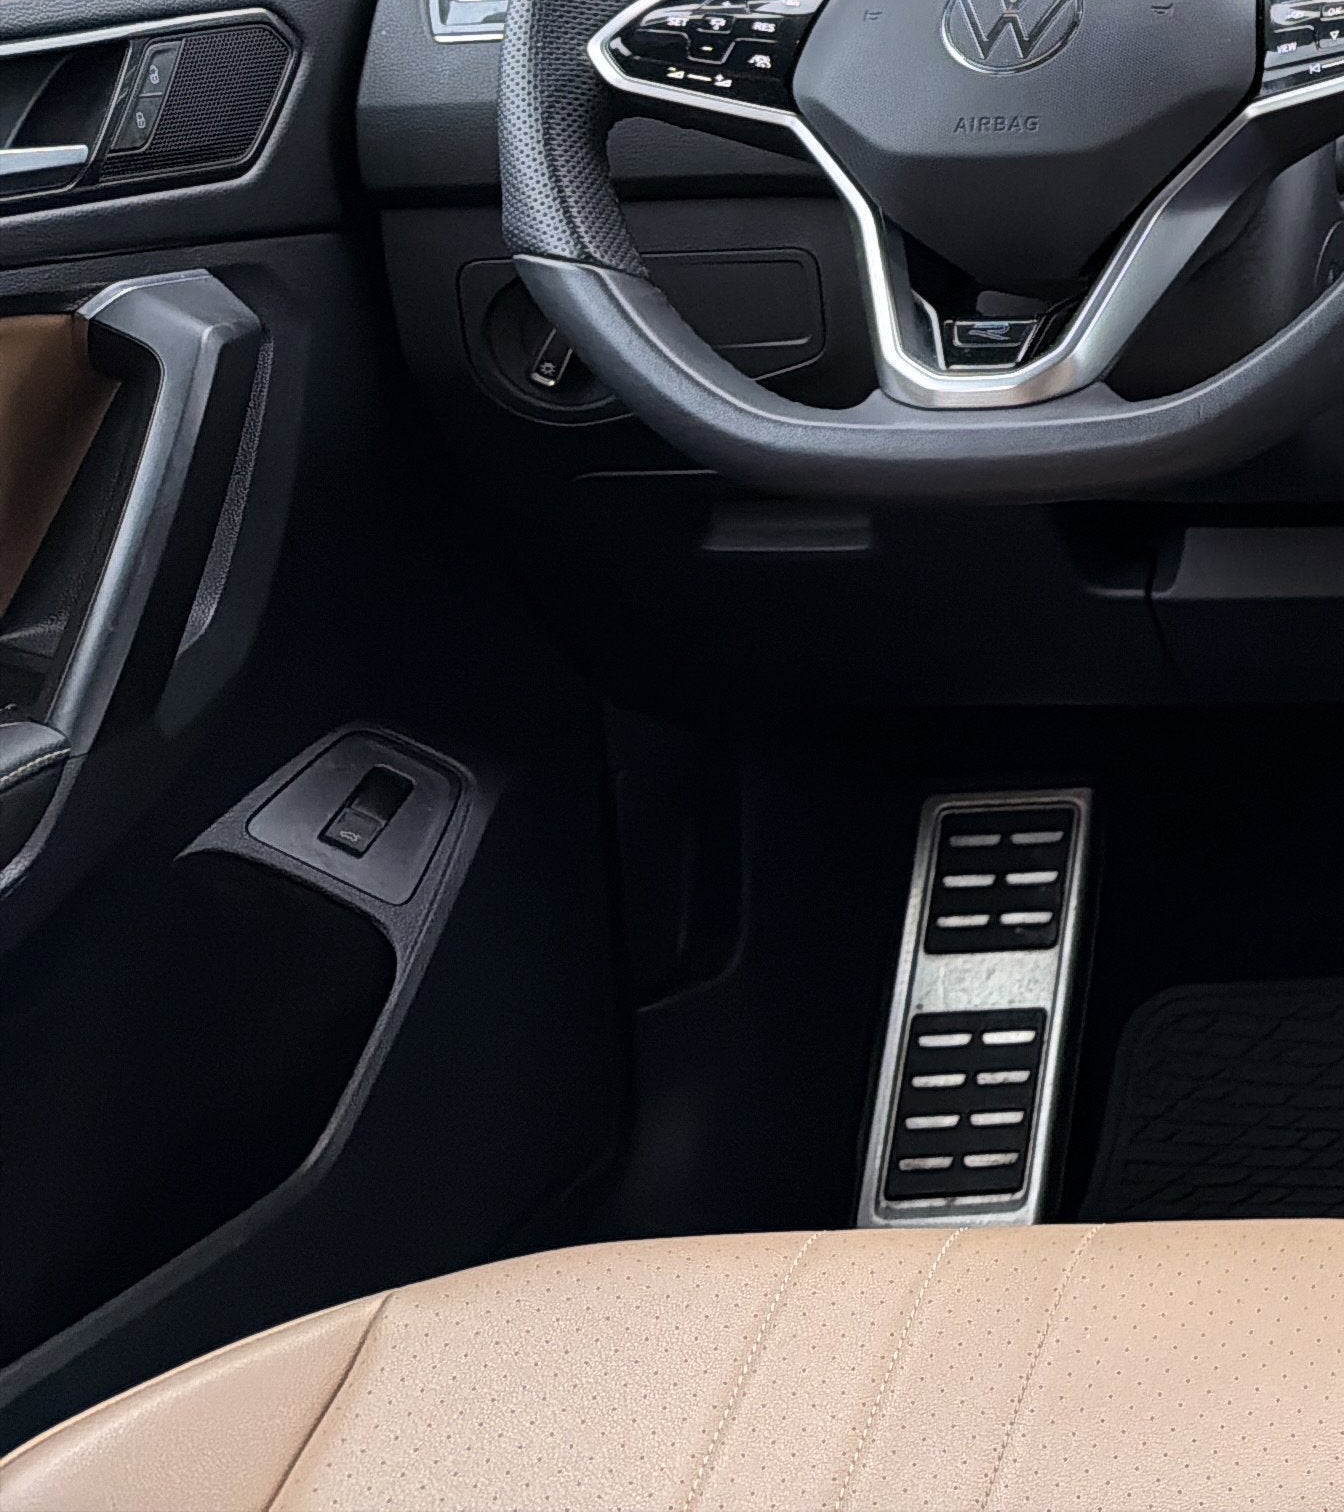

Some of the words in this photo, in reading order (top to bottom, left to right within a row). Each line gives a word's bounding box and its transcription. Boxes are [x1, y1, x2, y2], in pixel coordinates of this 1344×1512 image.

[753, 21, 776, 33] RES
[1277, 42, 1298, 54] VIEW
[953, 115, 1041, 134] AIRBAG
